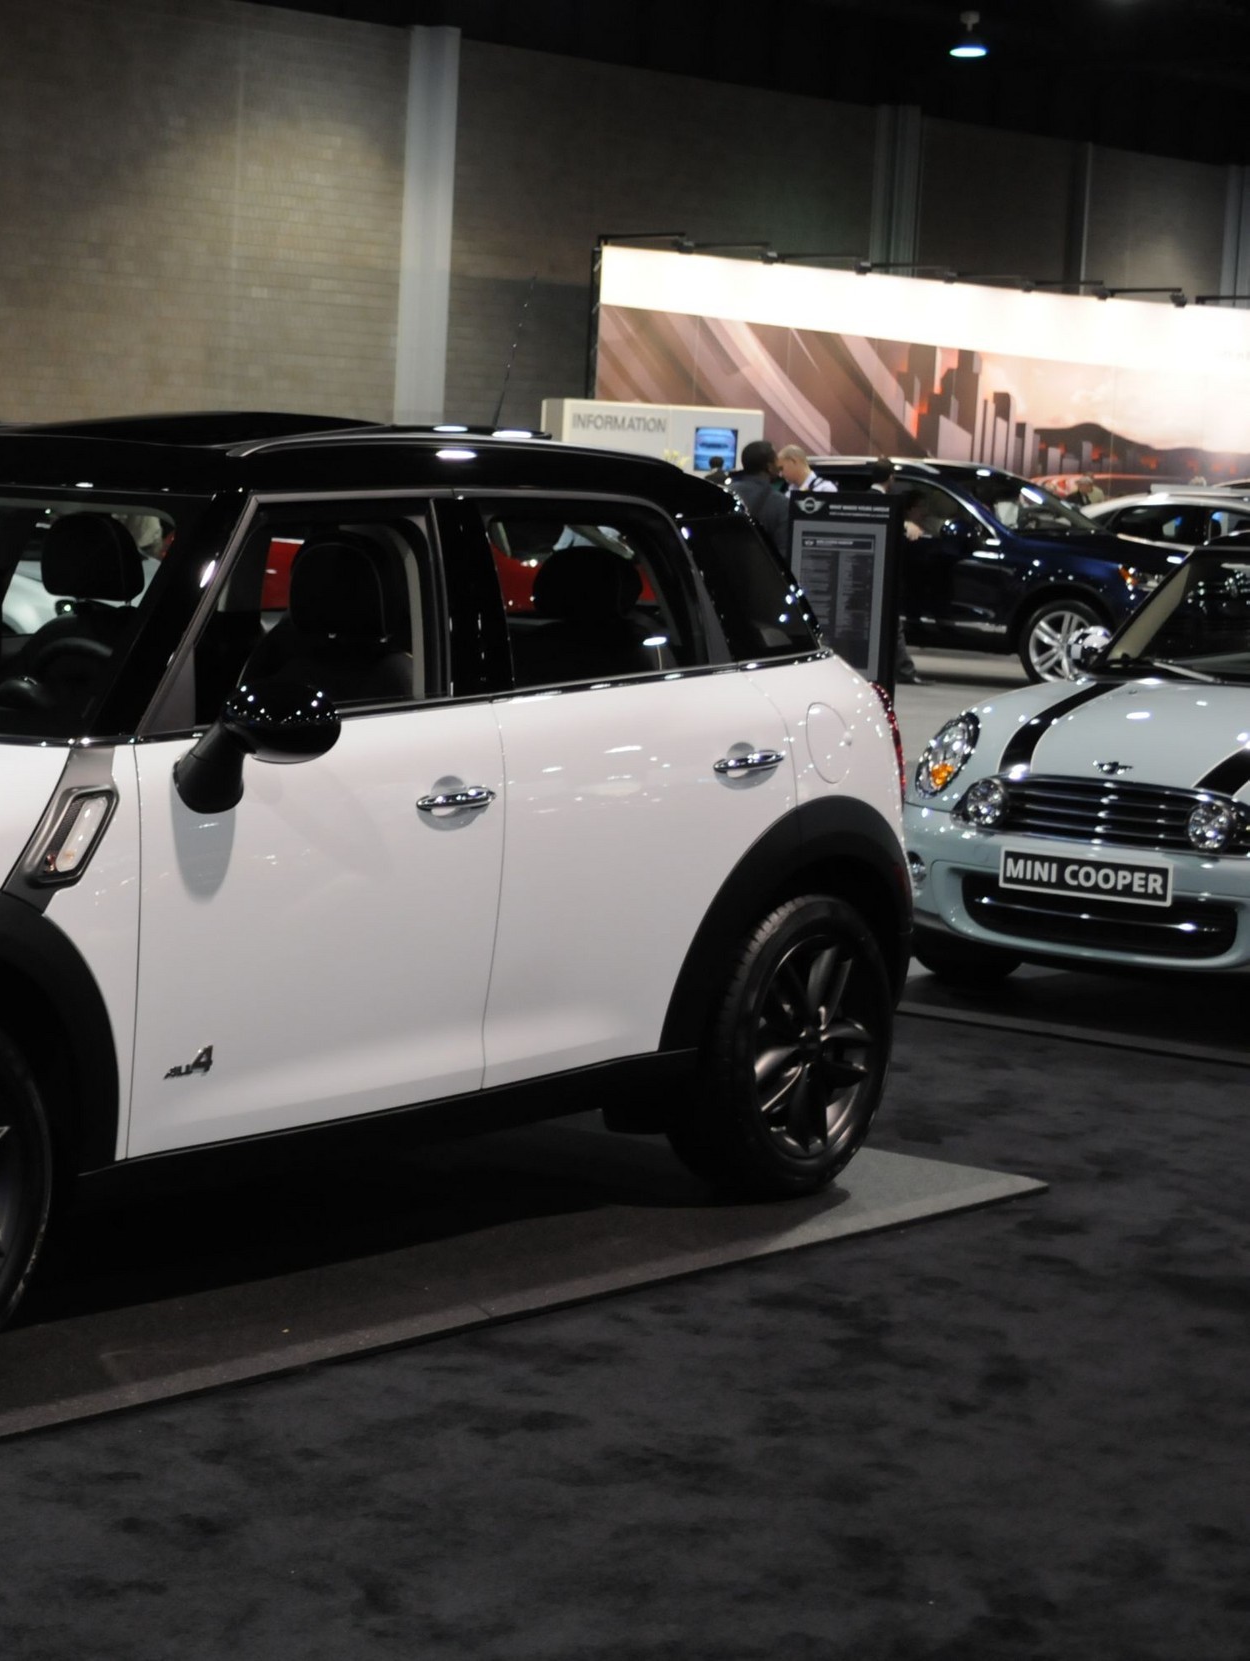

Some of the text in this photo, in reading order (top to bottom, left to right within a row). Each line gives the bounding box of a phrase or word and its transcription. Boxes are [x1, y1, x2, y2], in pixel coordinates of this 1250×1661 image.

[572, 412, 668, 433] INFORMATION
[1006, 857, 1164, 895] MINI COOPER
